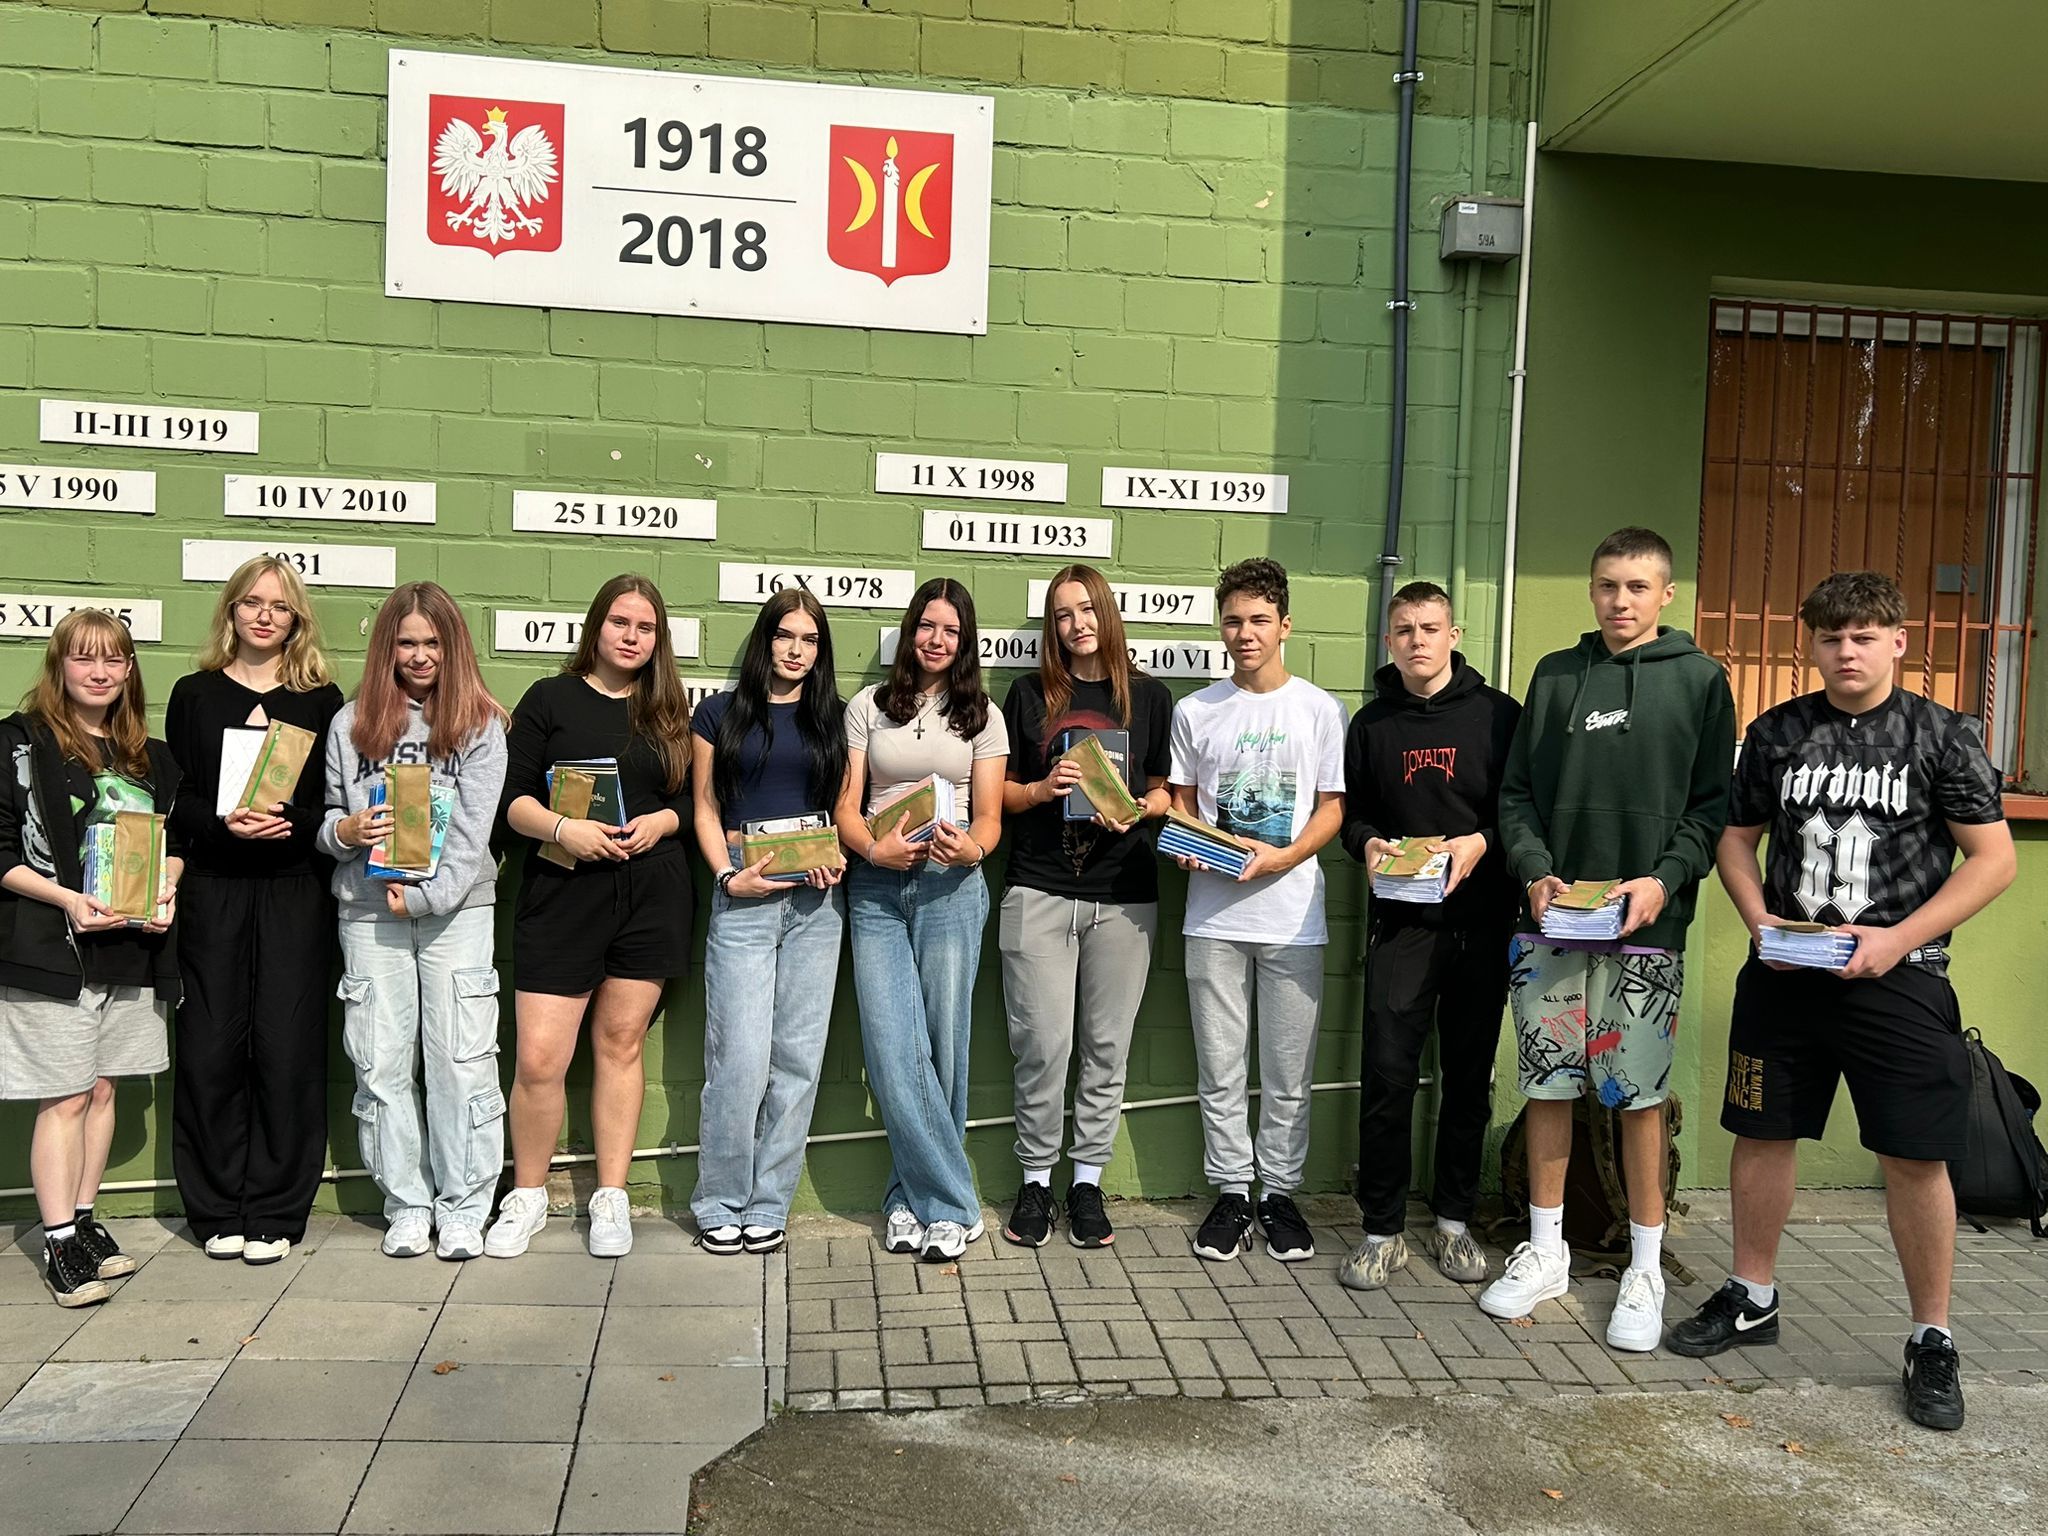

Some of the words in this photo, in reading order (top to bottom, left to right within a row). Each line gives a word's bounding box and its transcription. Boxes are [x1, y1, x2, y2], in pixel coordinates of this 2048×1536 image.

[624, 117, 768, 177] 1918
[619, 213, 768, 272] 2018
[74, 411, 150, 438] II-III
[163, 417, 228, 442] 1919
[16, 474, 41, 498] V
[52, 476, 118, 502] 1990
[912, 464, 934, 487] 11
[946, 466, 968, 488] X
[979, 468, 1035, 492] 1998
[1126, 476, 1199, 500] IX-XI
[1210, 480, 1265, 503] 1939
[257, 485, 288, 508] 10
[297, 486, 332, 509] IV
[342, 488, 407, 513] 2010
[554, 501, 585, 525] 25
[595, 503, 605, 525] I
[617, 505, 678, 529] 1920
[949, 519, 975, 541] 01
[987, 522, 1020, 544] III
[1031, 524, 1087, 548] 1933
[262, 552, 321, 576] 31
[755, 572, 784, 594] 16
[793, 574, 814, 594] X
[825, 576, 883, 599] 1978
[16, 604, 55, 628] XI
[1139, 593, 1195, 615] 1997
[524, 620, 556, 643] 07
[979, 637, 1038, 659] 2004
[1182, 648, 1212, 670] VI
[1402, 747, 1457, 786] LOYALTY
[1780, 760, 1910, 818] paranoid
[1793, 807, 1880, 923] 69
